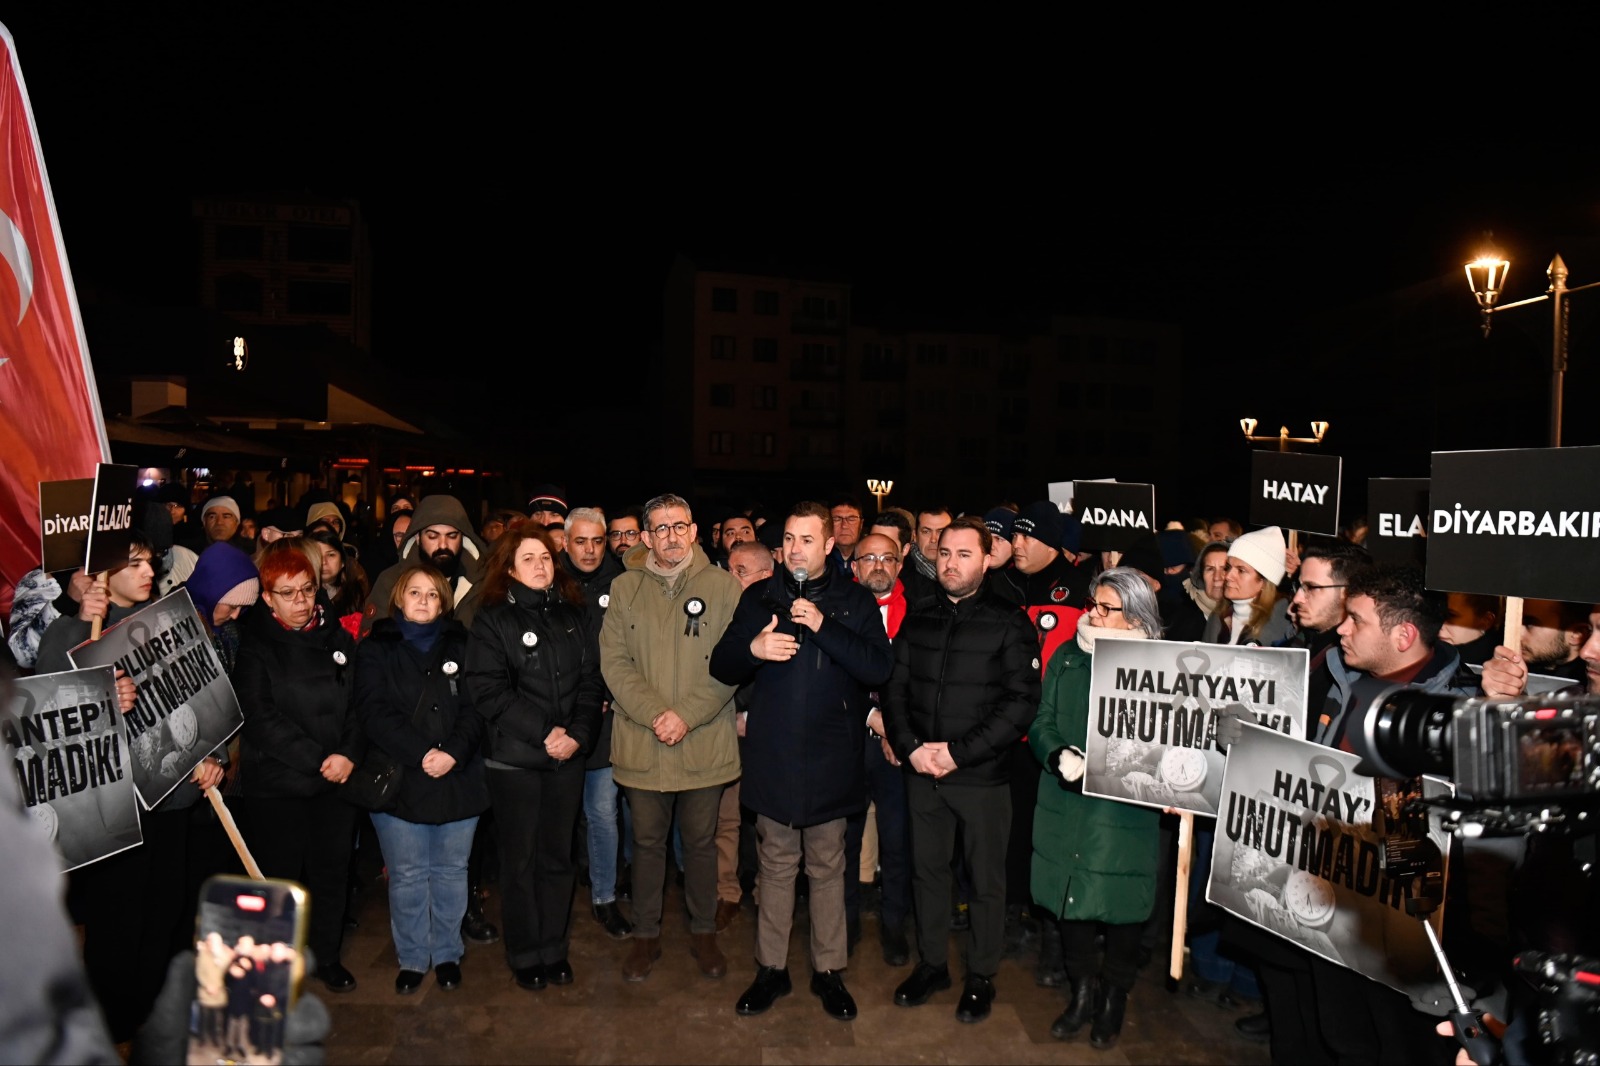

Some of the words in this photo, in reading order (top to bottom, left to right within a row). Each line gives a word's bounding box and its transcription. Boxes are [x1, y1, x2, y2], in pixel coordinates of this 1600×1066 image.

[1263, 479, 1329, 505] HATAY
[44, 513, 91, 536] DİYAR
[96, 498, 132, 532] ELAZIĞ
[1081, 507, 1150, 529] ADANA
[1379, 513, 1428, 538] ELA
[114, 615, 200, 678] NLIURFA'YI
[124, 641, 220, 746] NUTMADIK!
[1115, 667, 1276, 705] MALATYA'YI
[3, 690, 117, 750] ANTEP'İ
[15, 733, 124, 808] MADIK!
[1273, 769, 1371, 824] HATAY'
